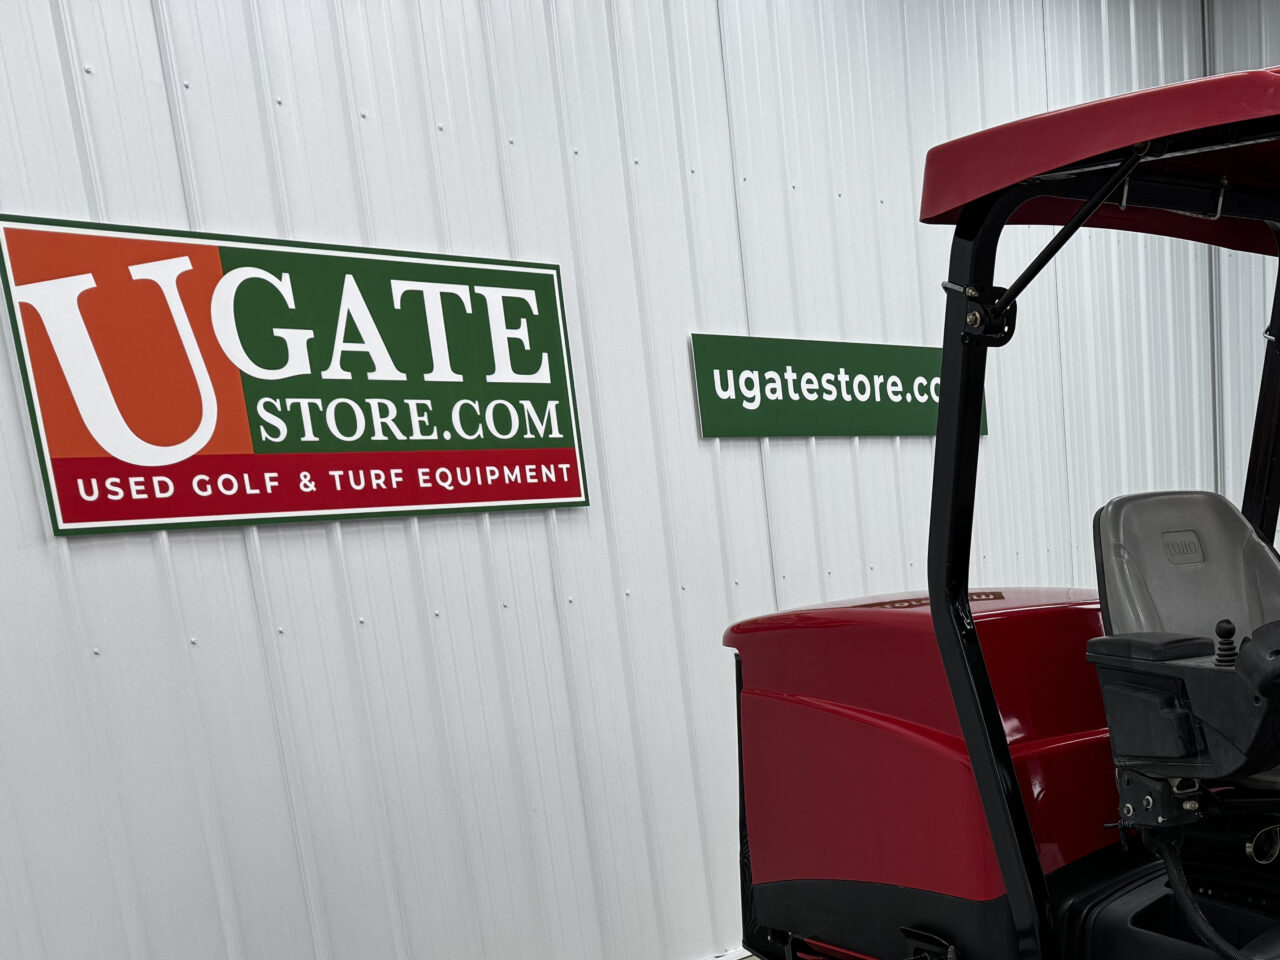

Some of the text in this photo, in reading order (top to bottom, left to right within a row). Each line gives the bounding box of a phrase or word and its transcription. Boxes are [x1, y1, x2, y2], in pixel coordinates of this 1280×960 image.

[14, 255, 551, 466] UGATE
[712, 365, 942, 410] ugatestore.co
[256, 396, 564, 443] STORE.COM
[77, 463, 572, 501] USED GOLF & TURF EQUIPMENT
